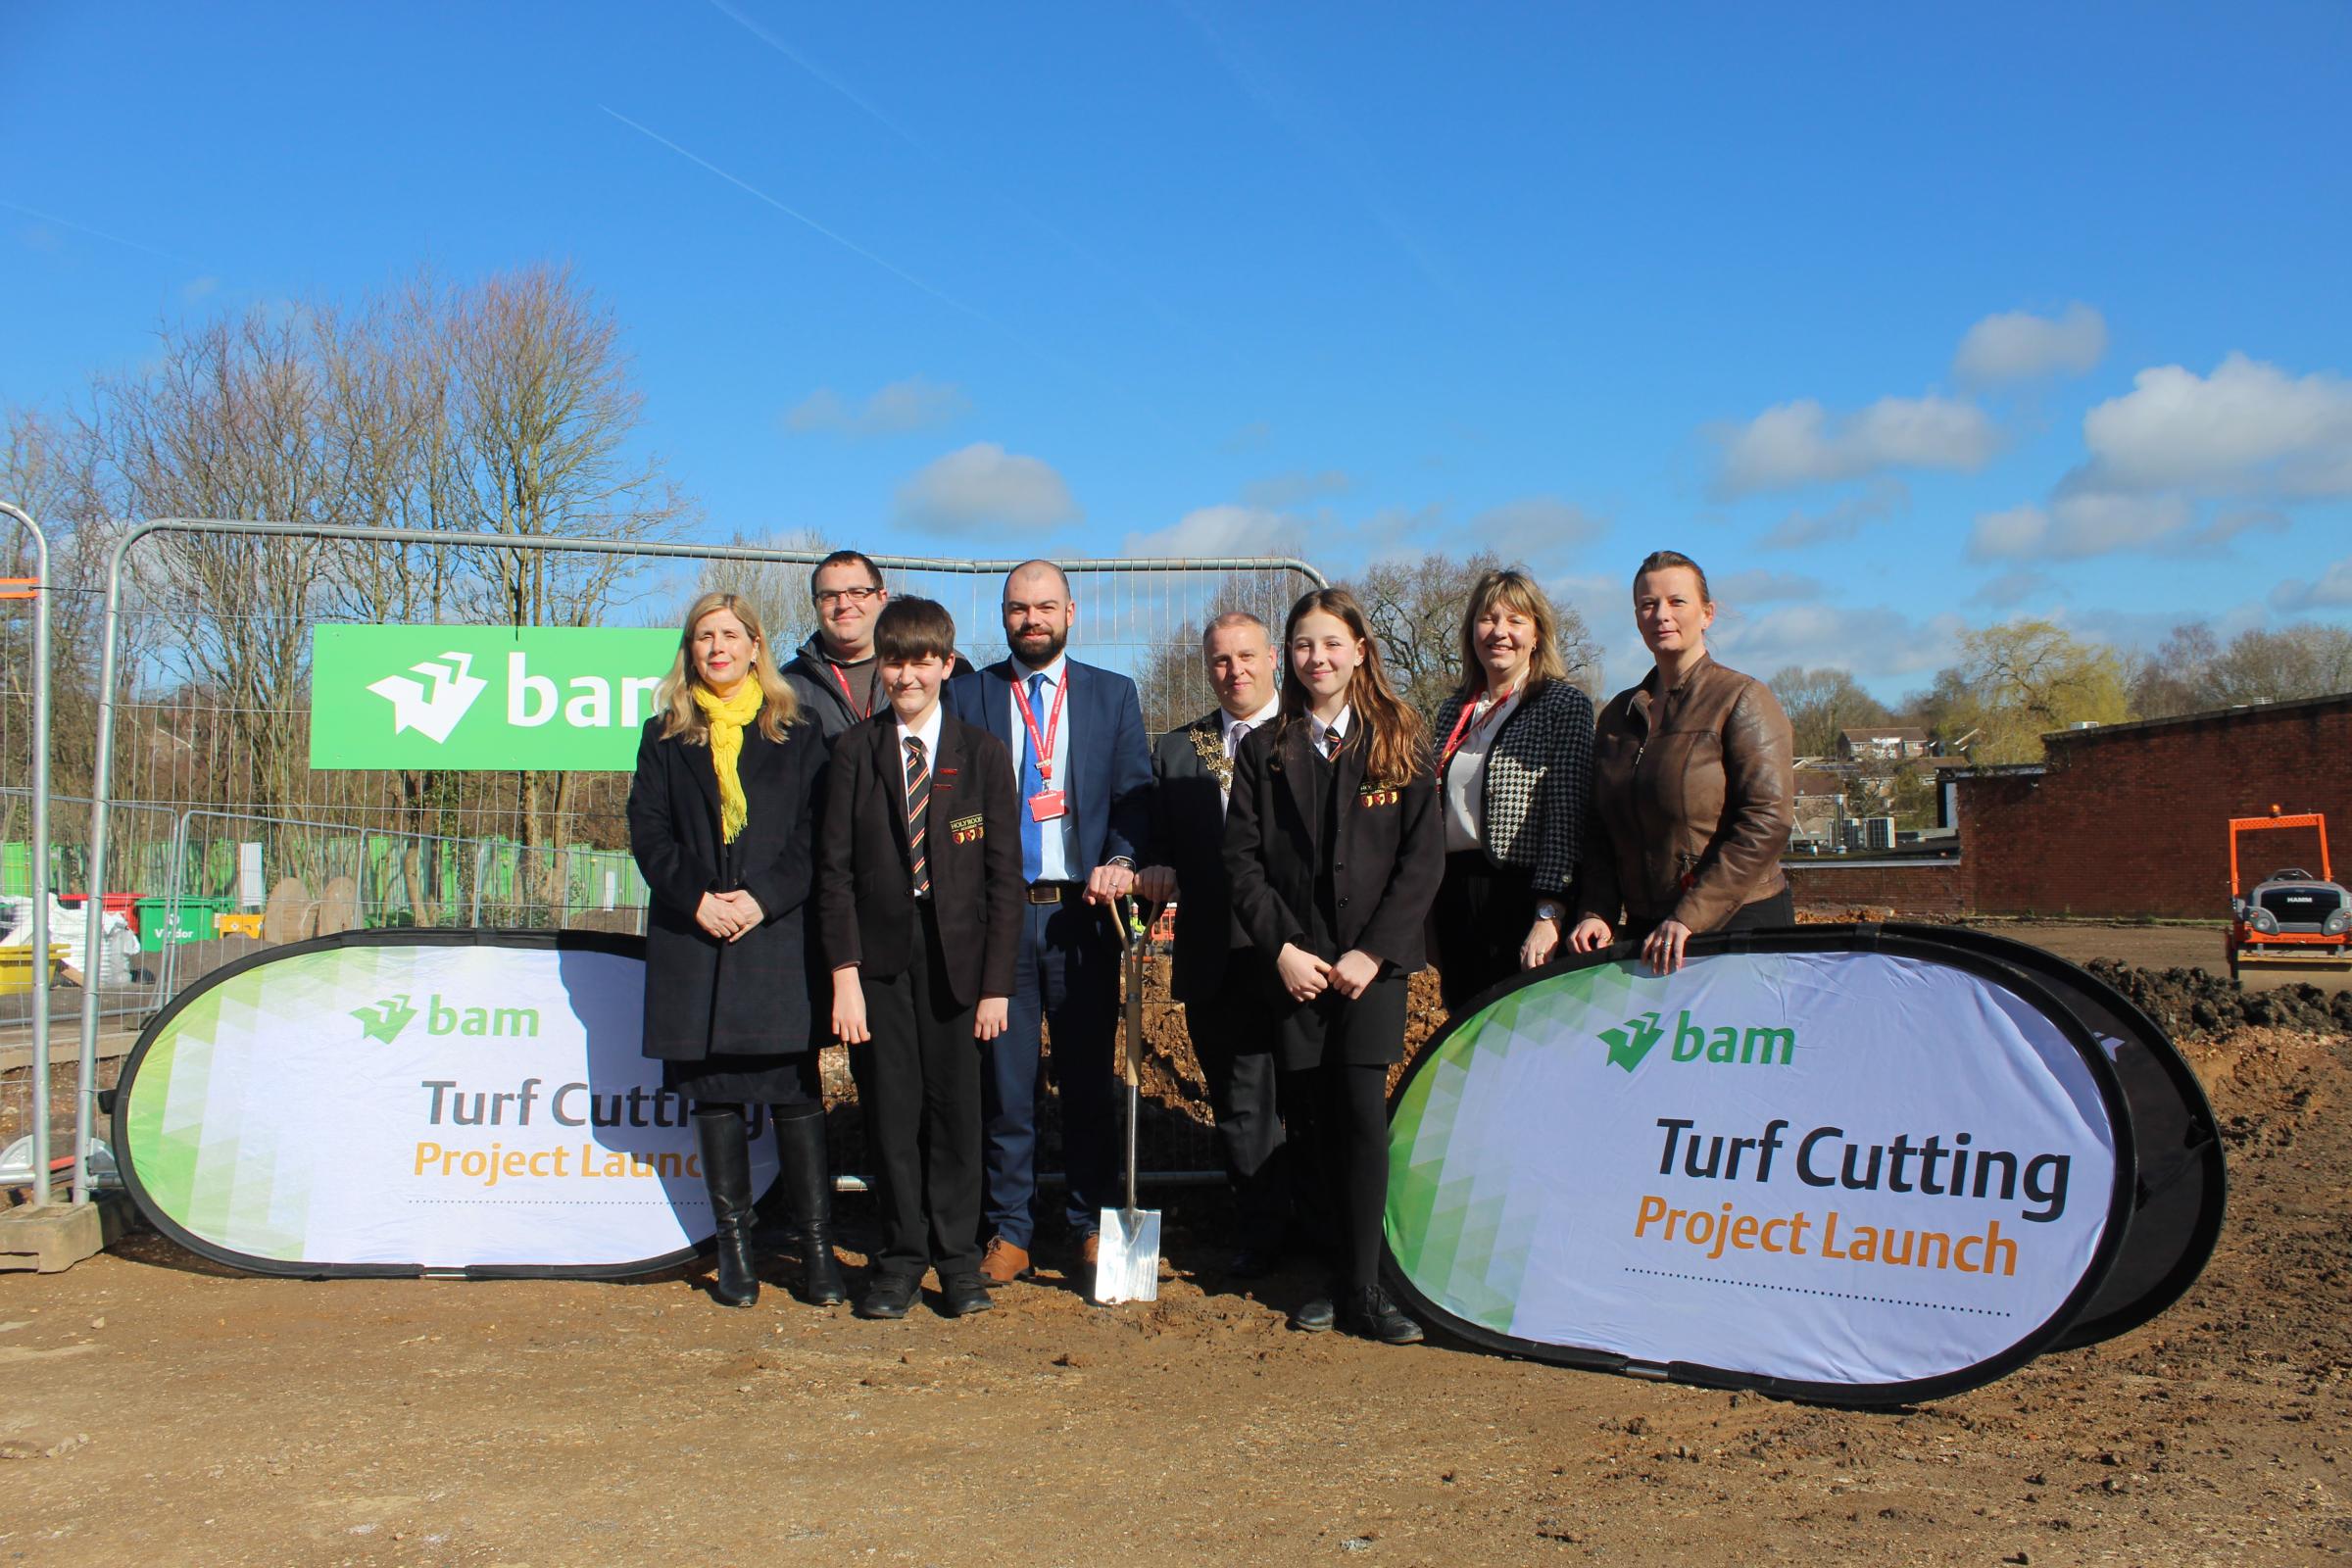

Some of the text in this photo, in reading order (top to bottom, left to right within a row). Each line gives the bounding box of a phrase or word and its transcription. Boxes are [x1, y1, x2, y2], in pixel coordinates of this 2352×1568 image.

[154, 929, 193, 938] Vrdor
[428, 996, 539, 1036] bam
[1672, 1009, 1795, 1066] bam
[421, 1078, 764, 1141] Turf Cutti
[414, 1142, 703, 1187] Project Launc
[1656, 1117, 2071, 1224] Turf Cutting
[1634, 1195, 2018, 1277] Project Launch
